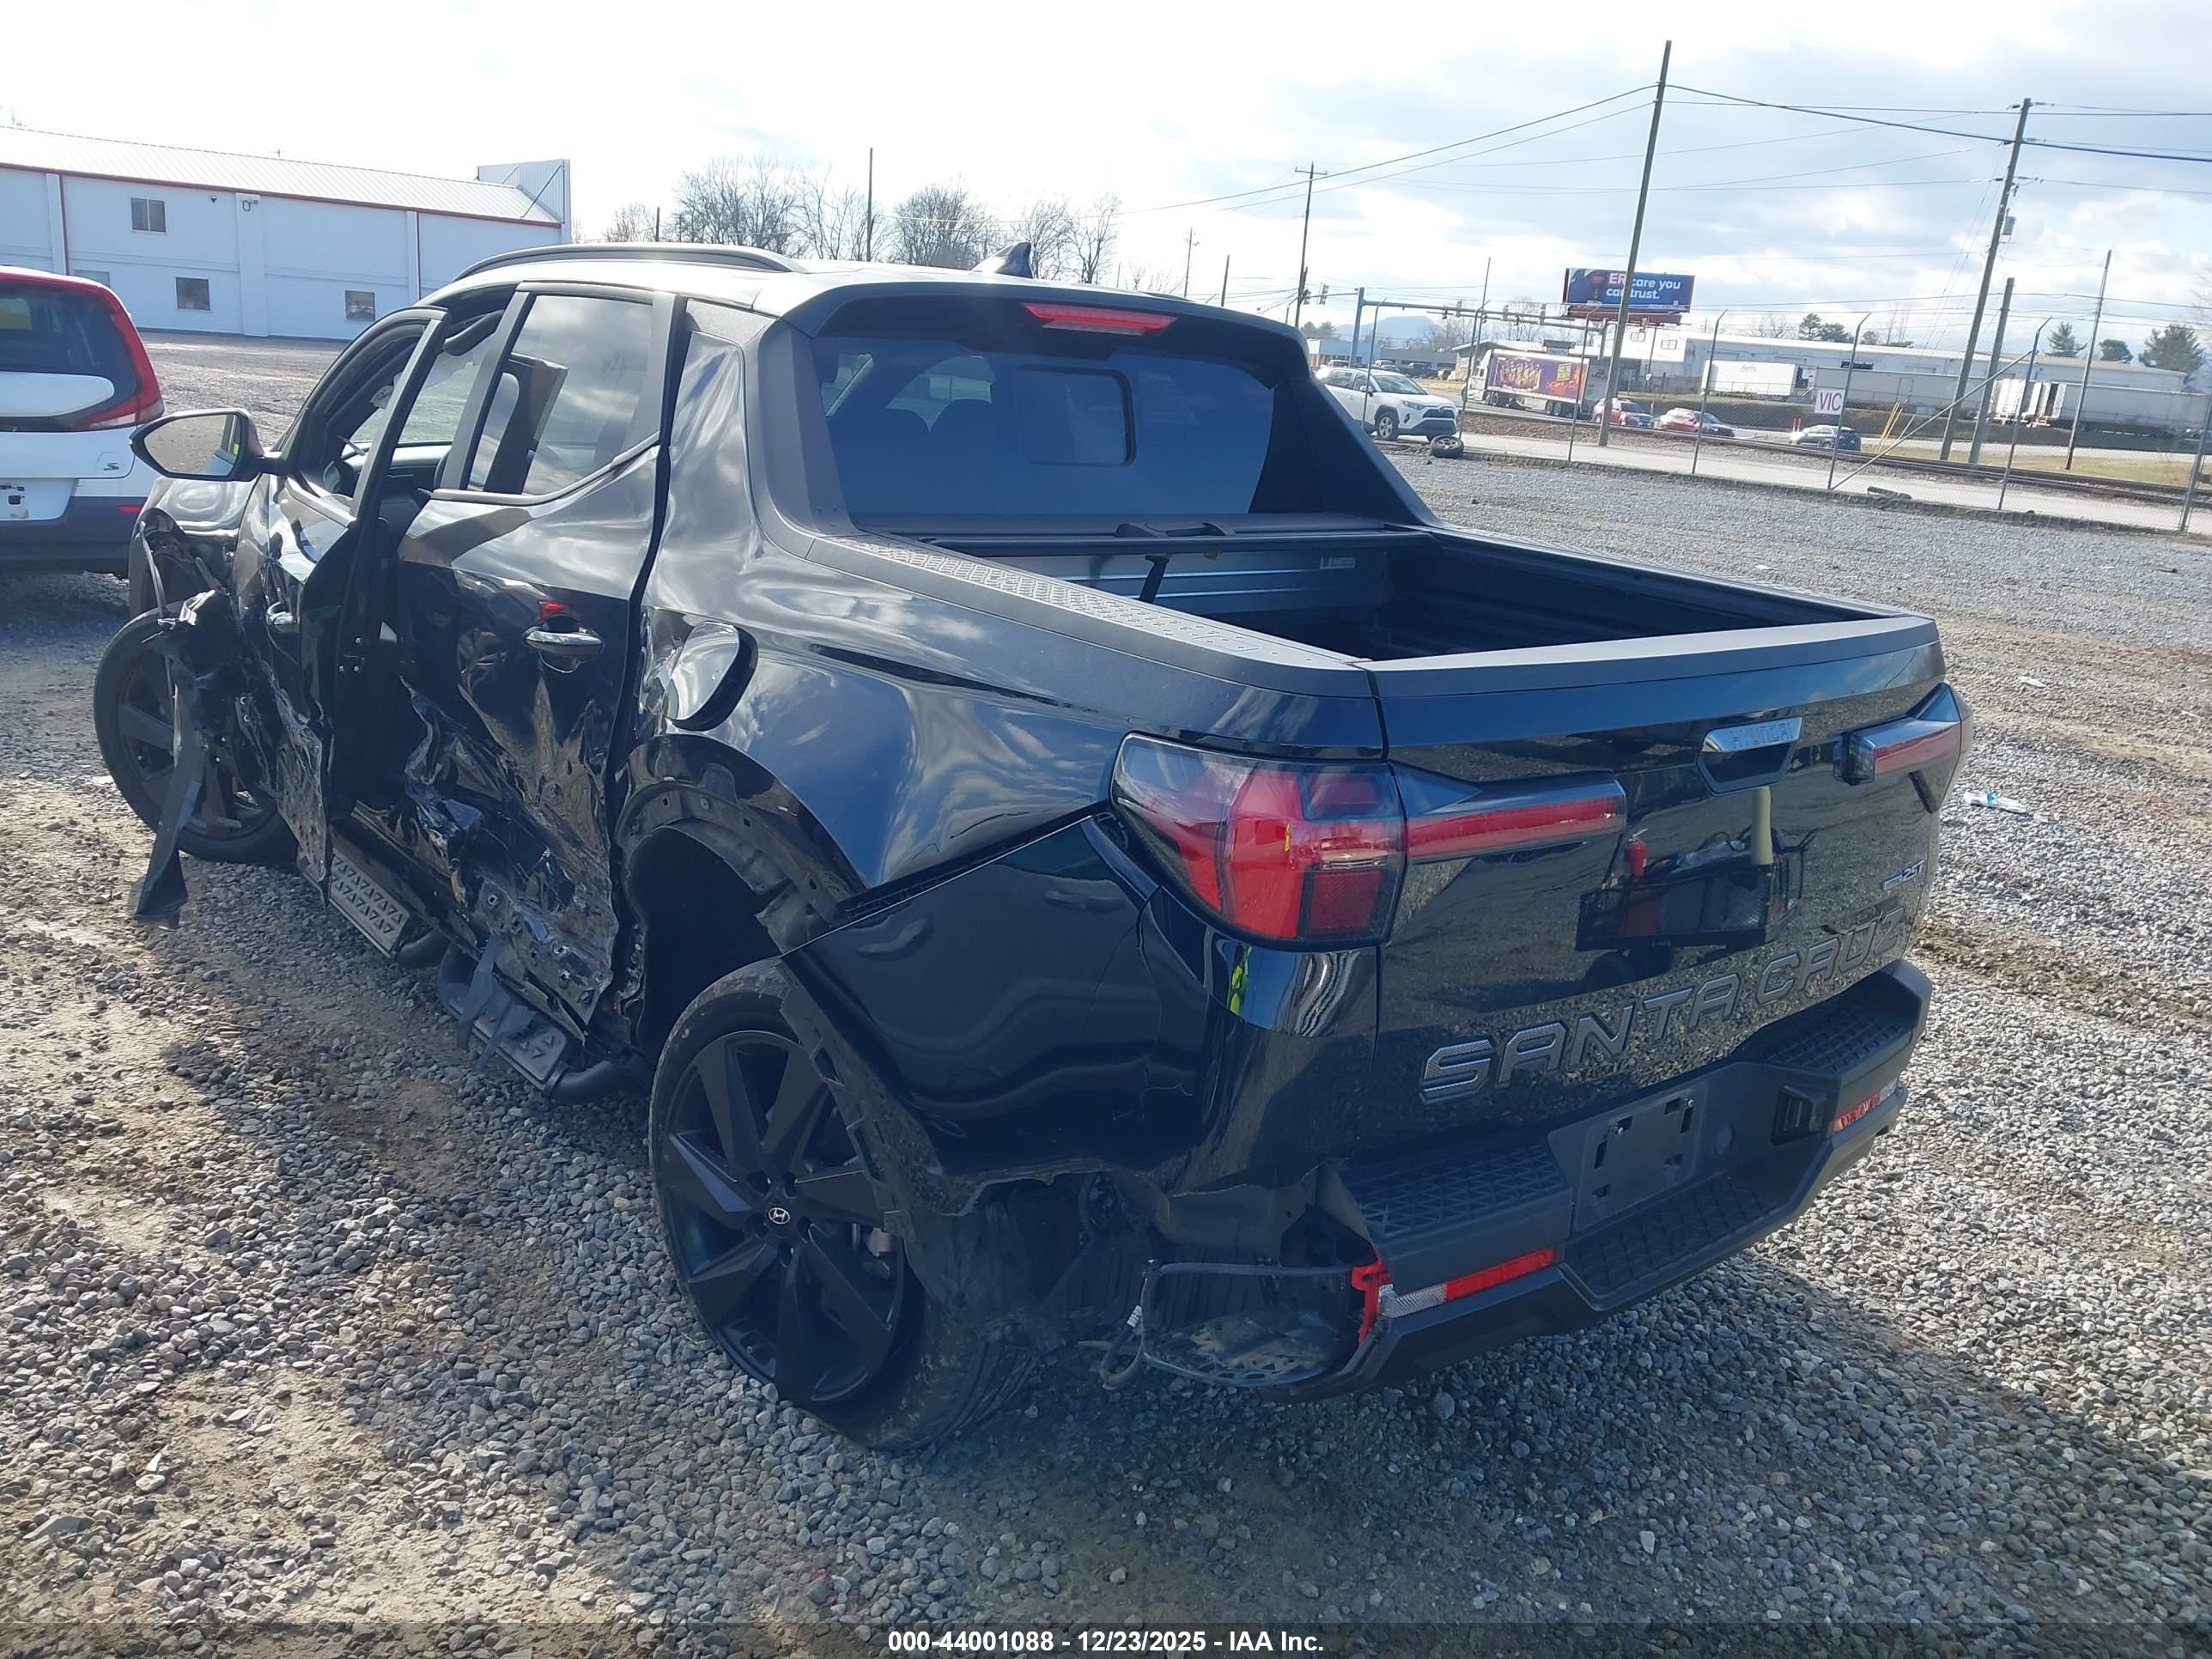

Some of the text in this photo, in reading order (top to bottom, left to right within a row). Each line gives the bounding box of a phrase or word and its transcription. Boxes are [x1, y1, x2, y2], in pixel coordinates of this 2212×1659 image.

[1658, 280, 1681, 291] you
[1606, 288, 1661, 300] ca trust.
[1820, 392, 1843, 411] VIC
[1419, 906, 1905, 1104] SANTA CRUZ
